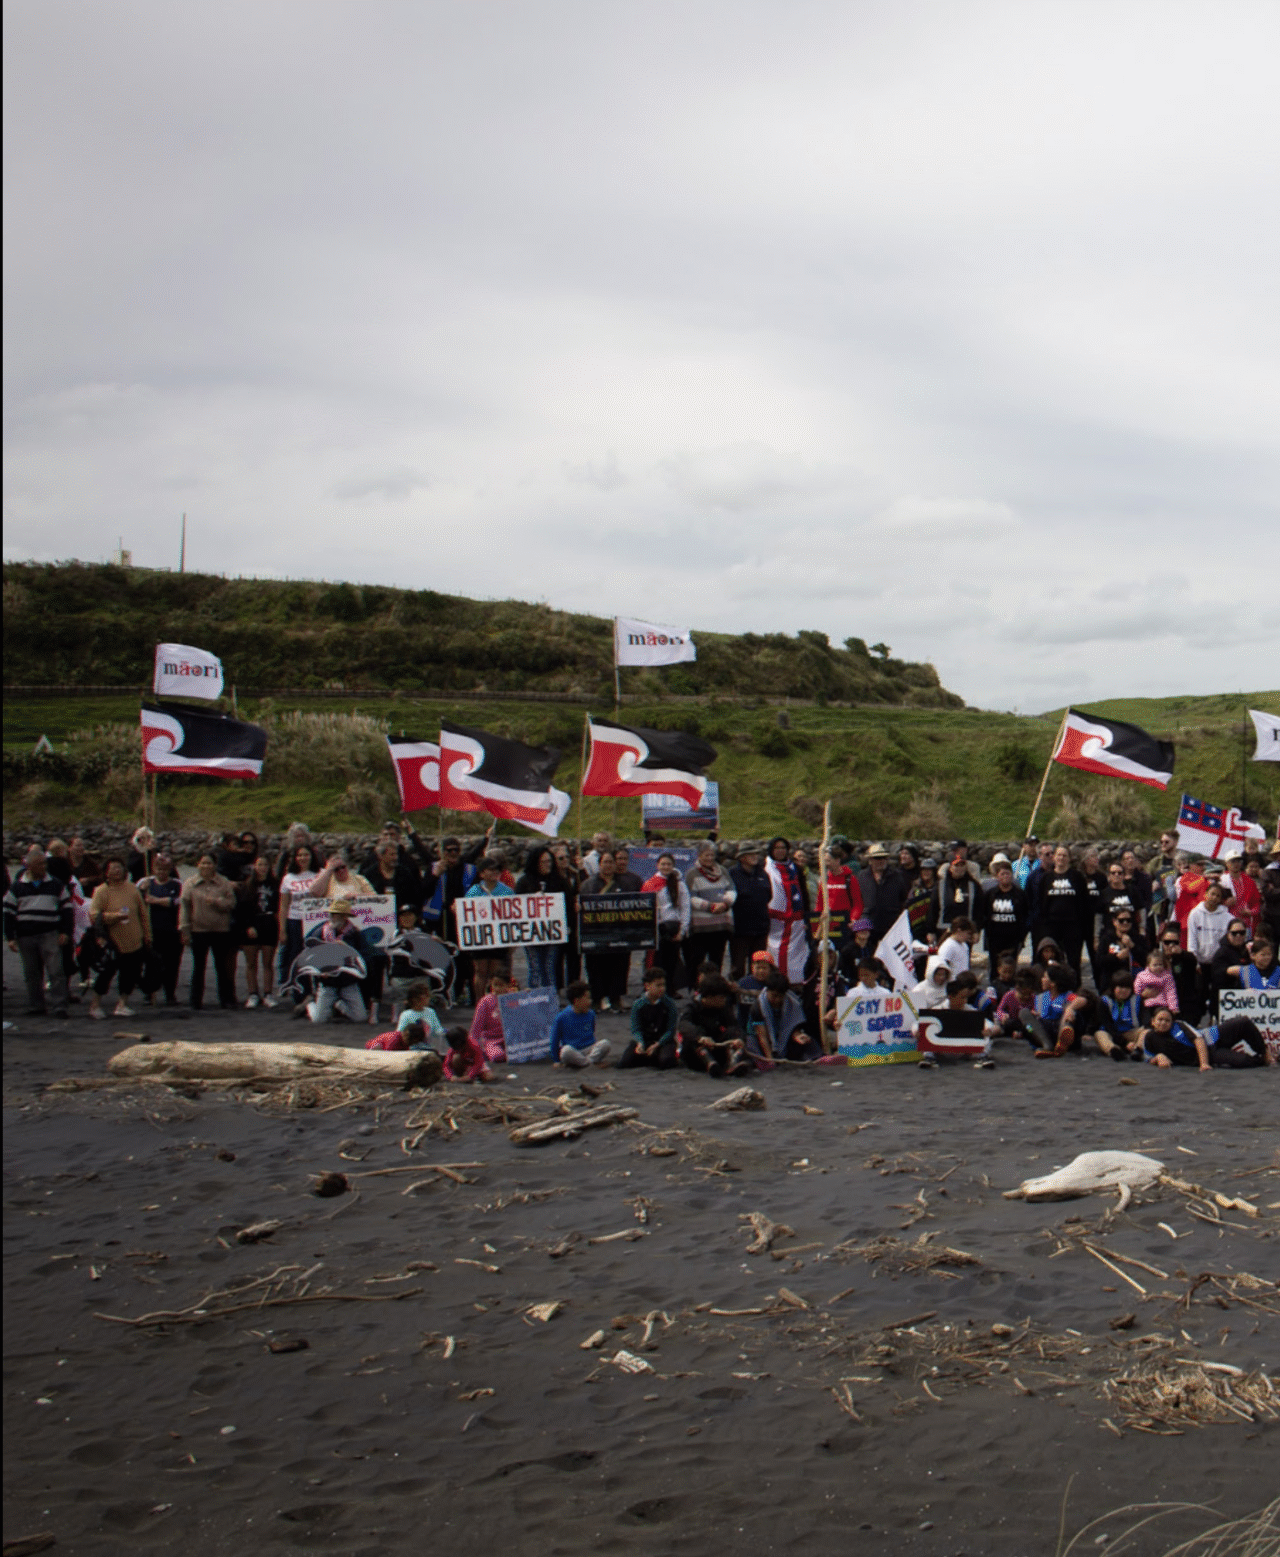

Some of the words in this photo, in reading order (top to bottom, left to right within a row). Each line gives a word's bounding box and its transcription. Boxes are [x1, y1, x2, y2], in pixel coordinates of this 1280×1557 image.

[164, 661, 218, 678] māori
[526, 896, 555, 918] OFF
[462, 923, 494, 946] OUR
[500, 920, 562, 944] OCEANS
[1224, 991, 1256, 1011] Save
[1258, 993, 1280, 1008] Our
